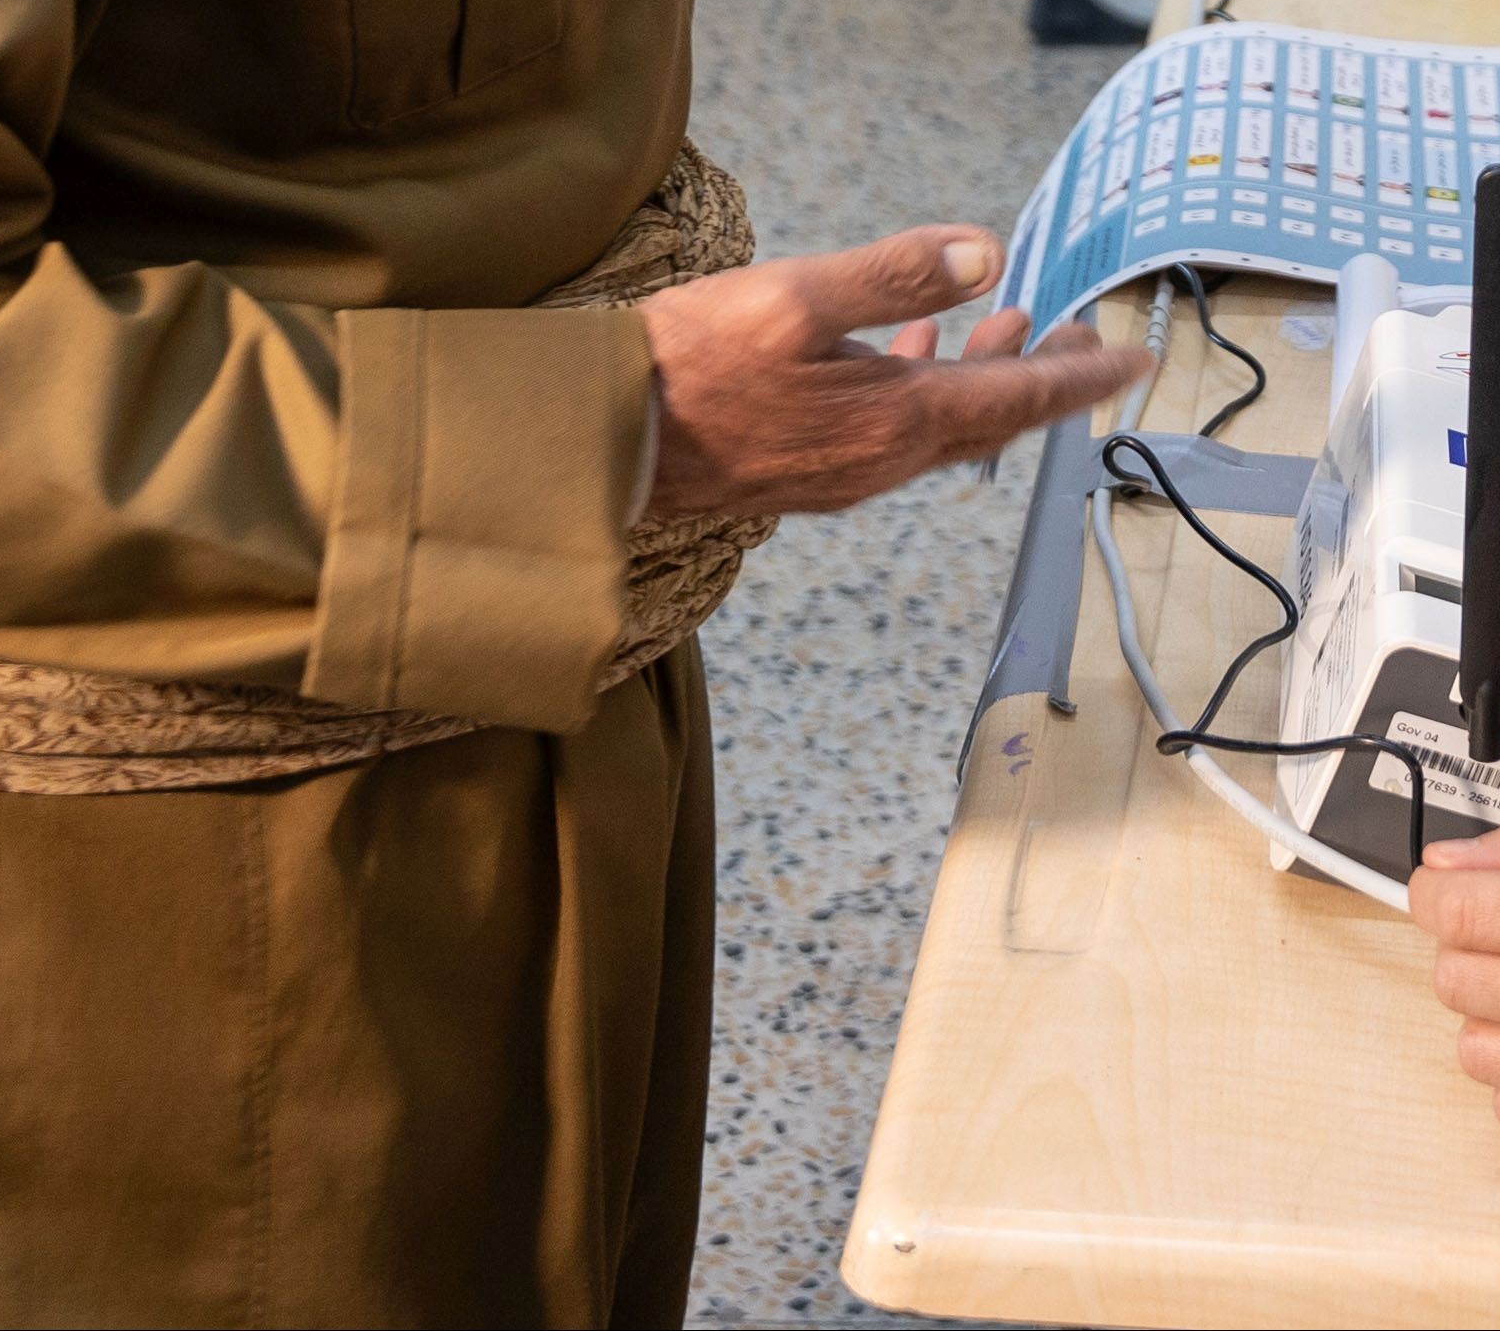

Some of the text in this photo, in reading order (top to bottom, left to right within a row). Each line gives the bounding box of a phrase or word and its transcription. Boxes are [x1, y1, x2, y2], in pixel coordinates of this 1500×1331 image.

[1396, 722, 1439, 743] Gov 04
[1404, 773, 1457, 796] 07639
